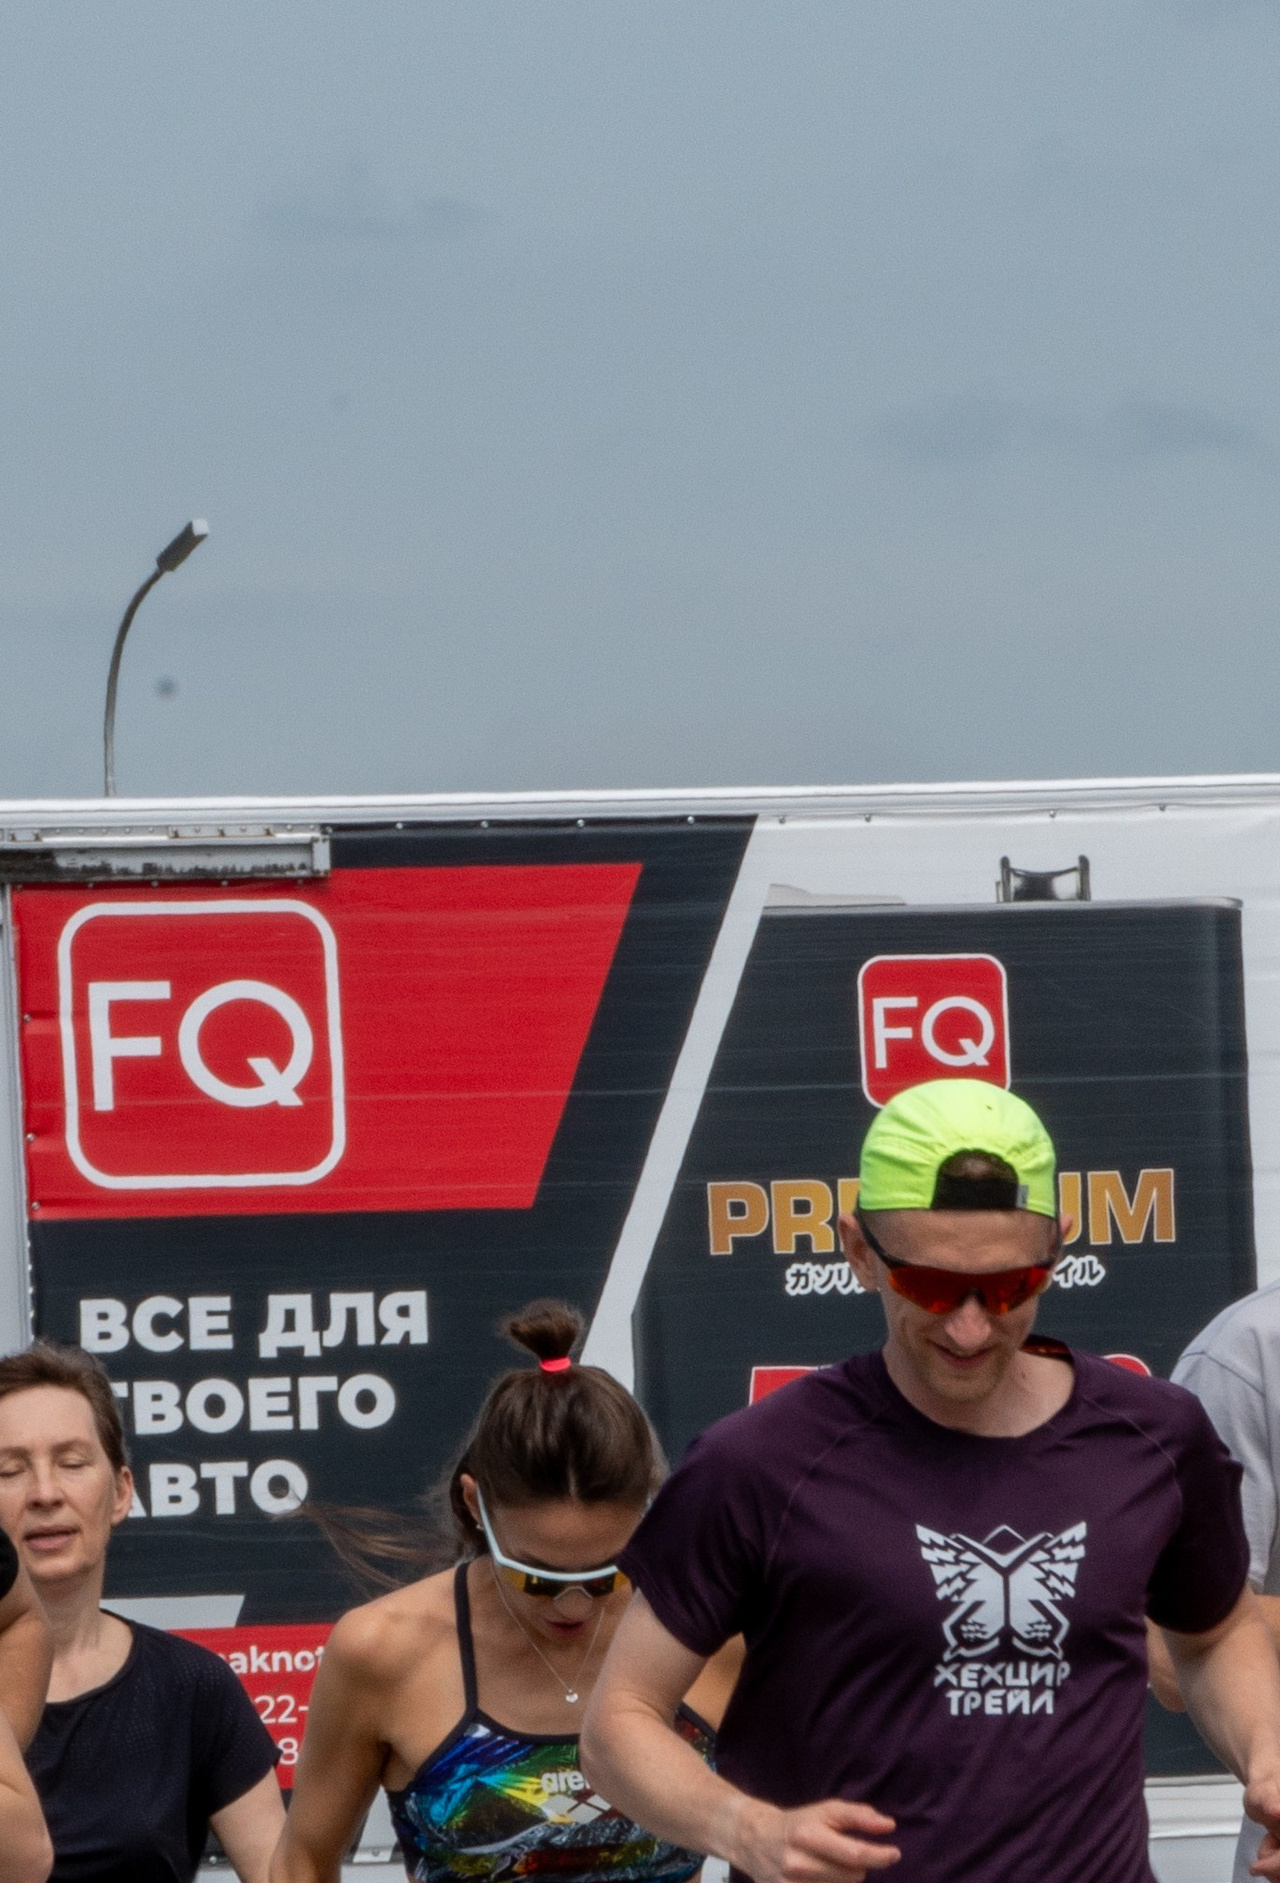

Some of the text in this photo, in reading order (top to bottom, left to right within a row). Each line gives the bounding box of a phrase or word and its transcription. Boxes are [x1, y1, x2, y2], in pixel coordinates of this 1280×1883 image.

[88, 979, 313, 1111] FQ
[871, 995, 995, 1069] FQ
[79, 1290, 430, 1358] ВСЕ ДЛЯ
[110, 1373, 396, 1436] ВОЕГО
[128, 1459, 309, 1518] ВТО
[216, 1645, 326, 1675] akno
[933, 1660, 1072, 1689] ХЕХЦИР
[945, 1688, 1056, 1716] ТРЕЙЛ
[541, 1770, 591, 1793] are
